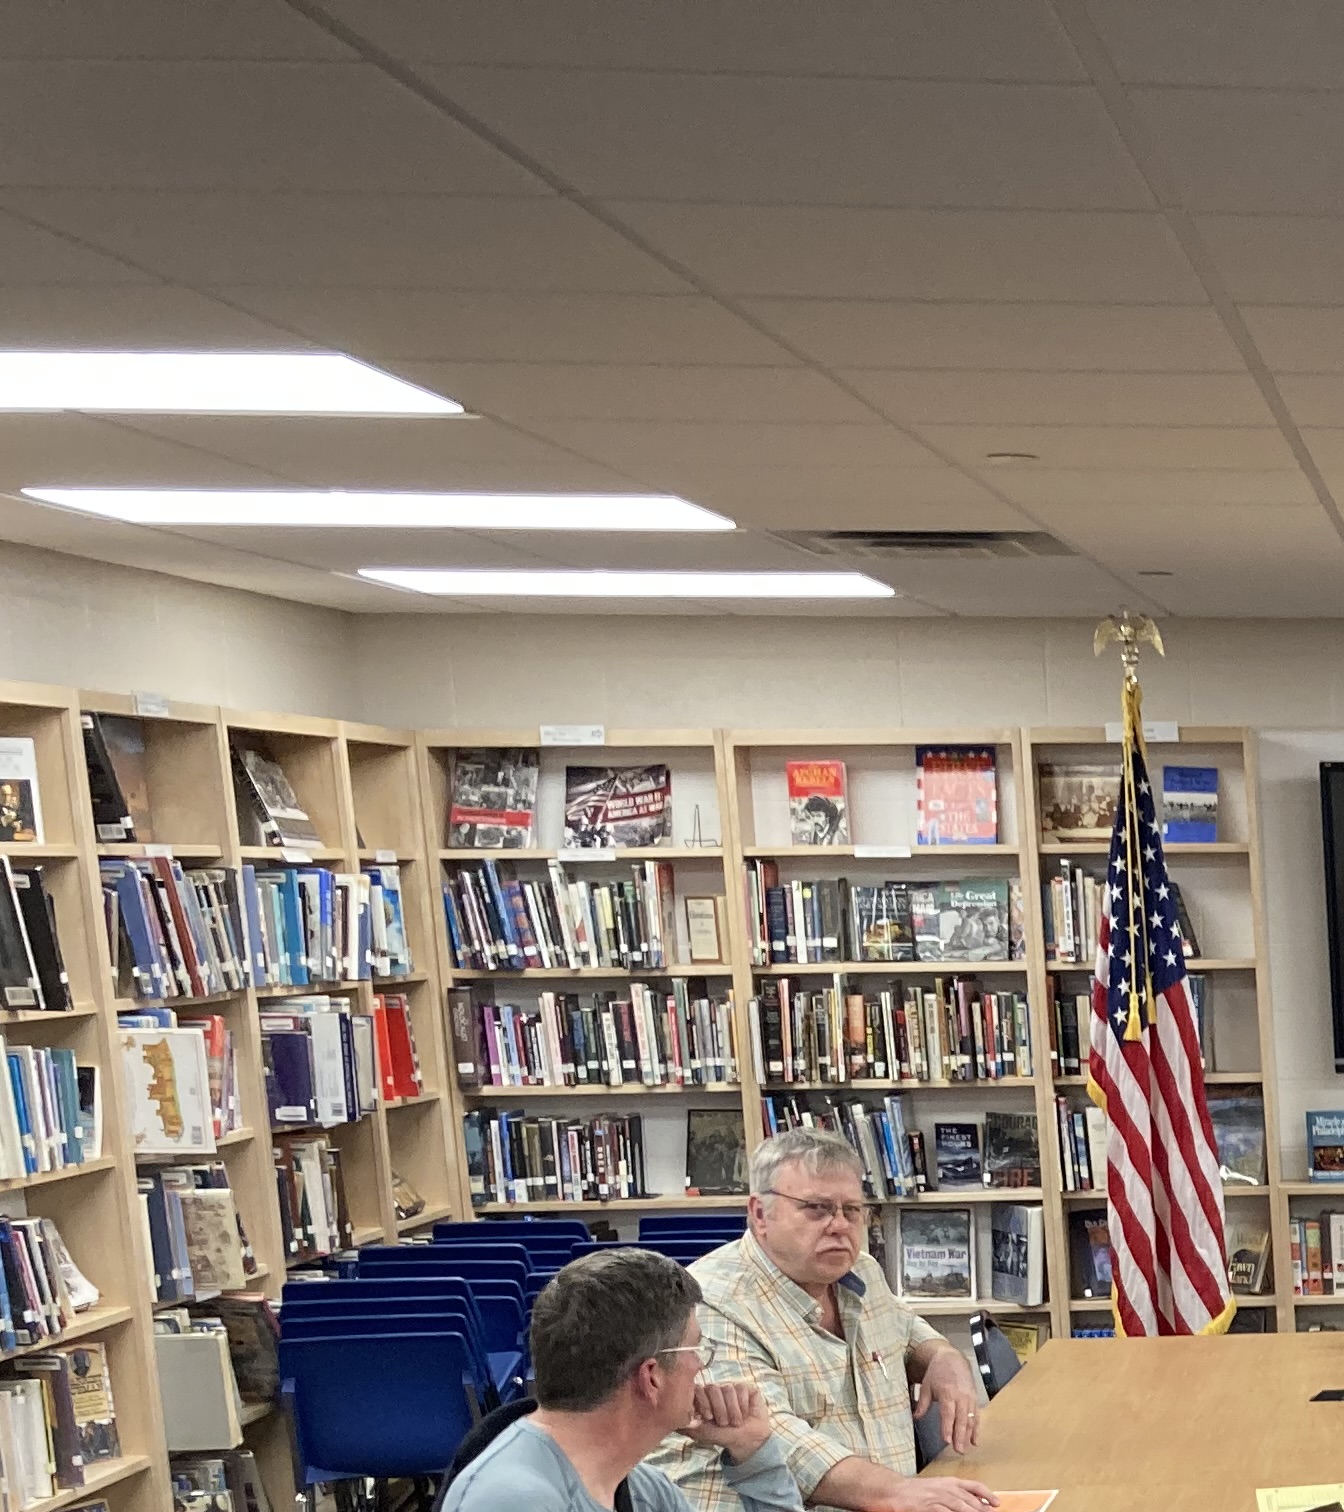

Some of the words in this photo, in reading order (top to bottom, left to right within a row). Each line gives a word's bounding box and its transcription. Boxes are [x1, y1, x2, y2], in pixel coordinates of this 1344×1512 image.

[965, 890, 996, 901] Great
[906, 1248, 946, 1260] Vietnam
[947, 1249, 967, 1259] War
